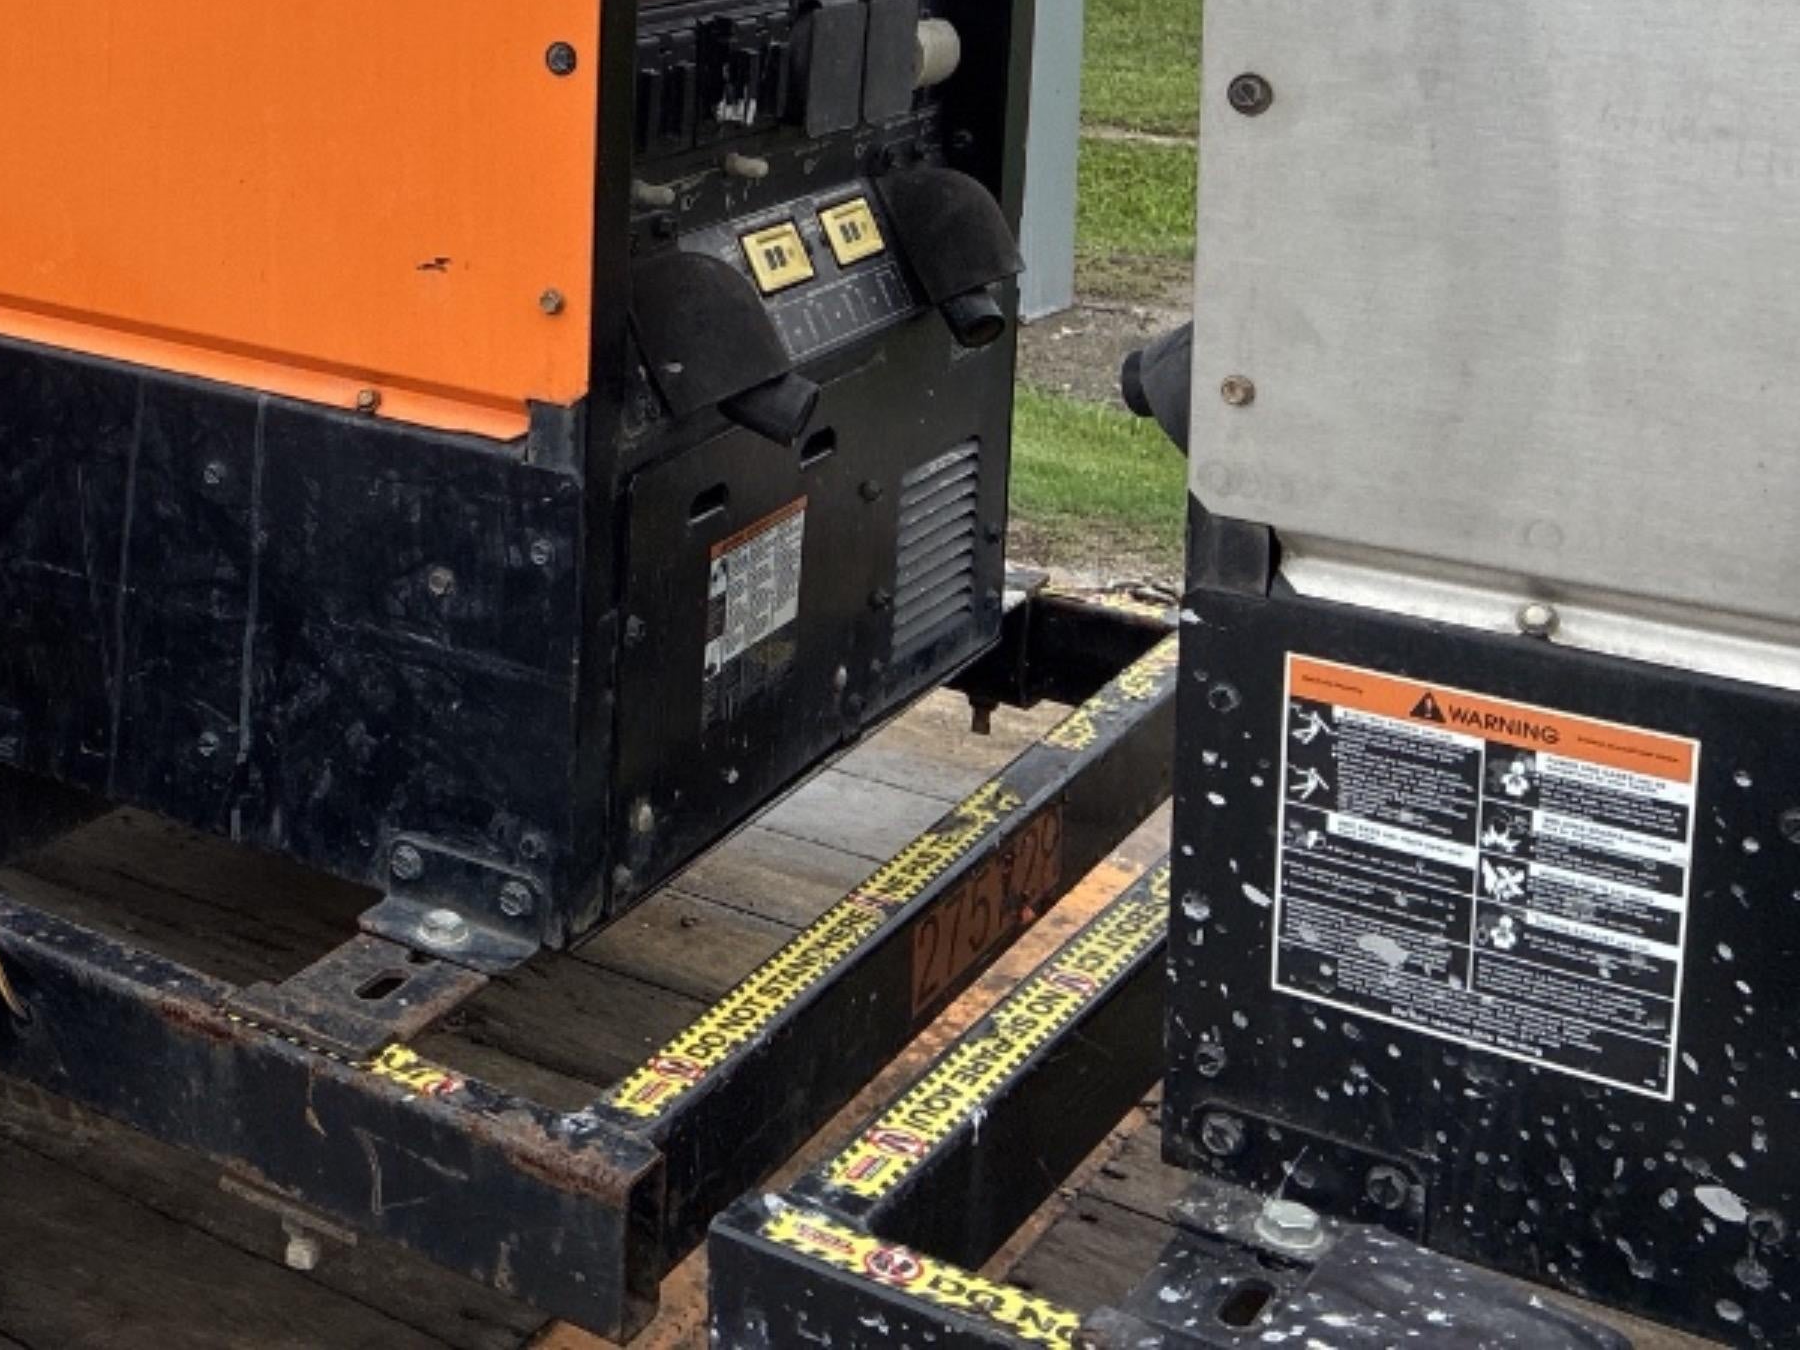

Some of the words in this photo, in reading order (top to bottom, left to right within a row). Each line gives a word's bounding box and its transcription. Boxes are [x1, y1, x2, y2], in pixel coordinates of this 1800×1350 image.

[1447, 703, 1561, 746] WARNING
[918, 807, 1061, 1004] 27529
[684, 1031, 728, 1060] DO
[723, 995, 768, 1033] NOT
[1025, 990, 1071, 1016] NO
